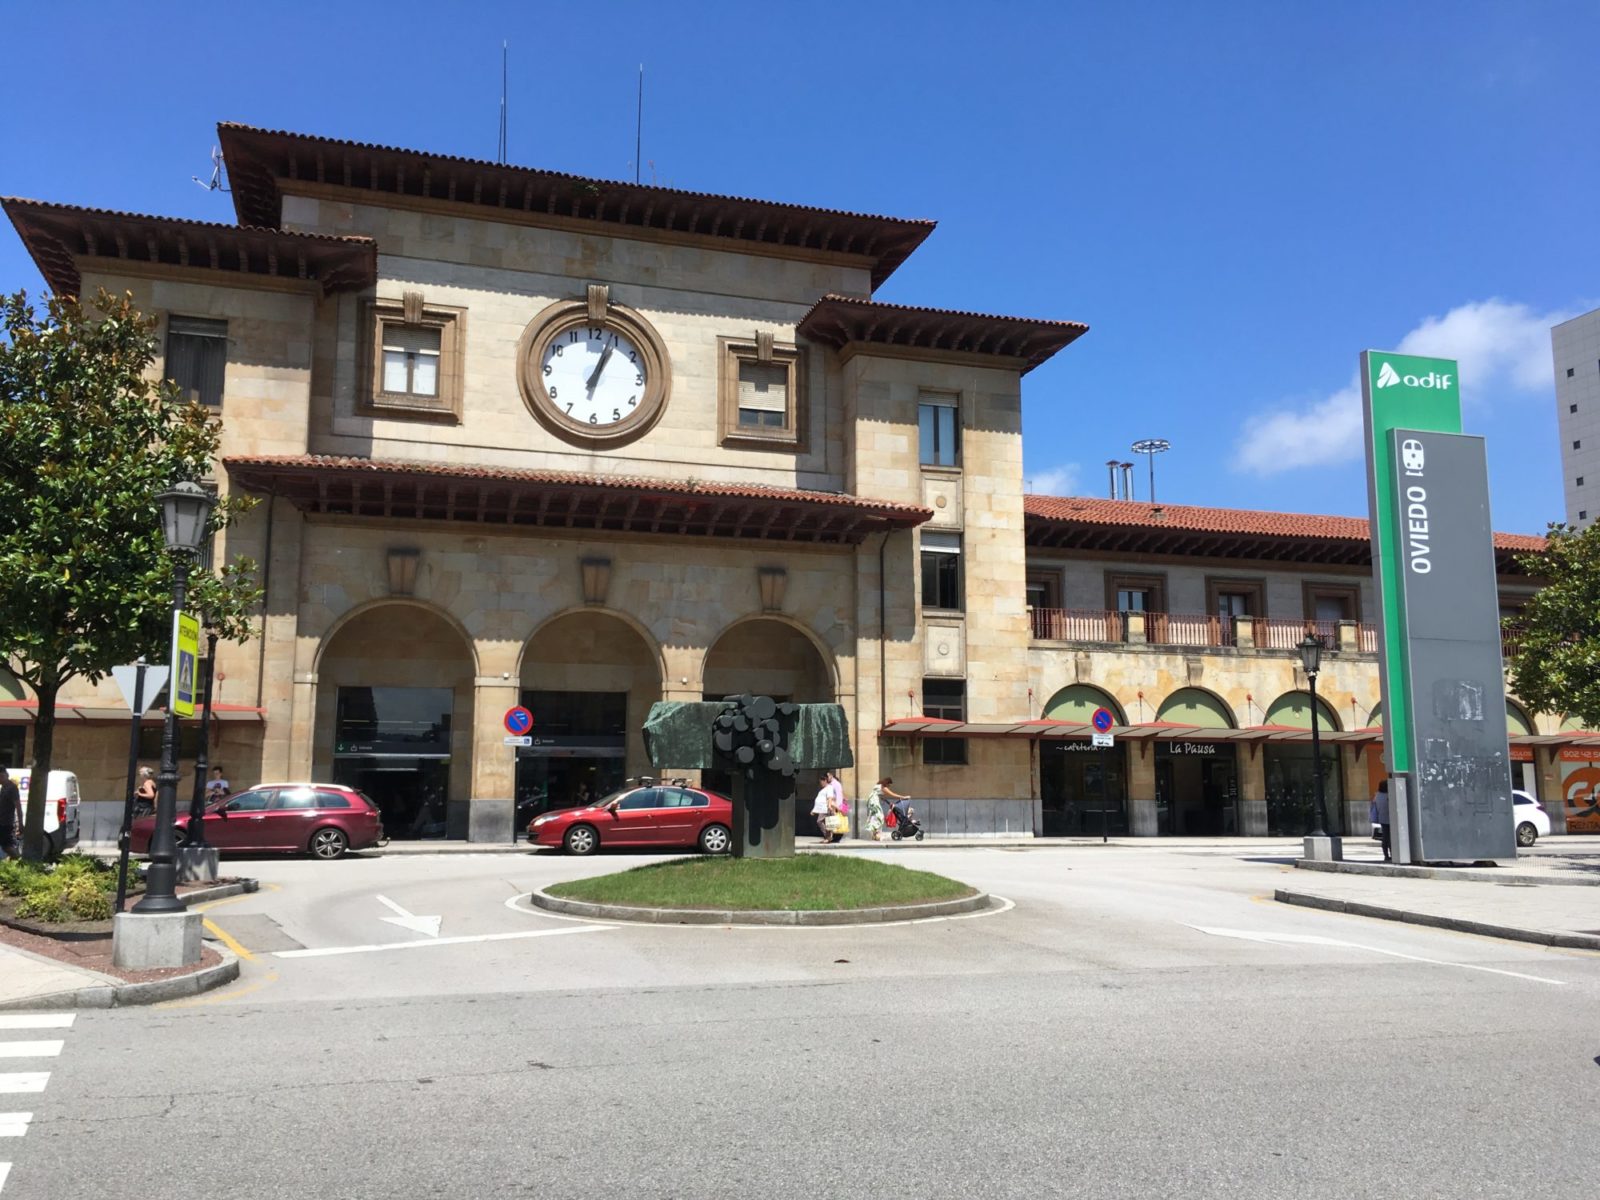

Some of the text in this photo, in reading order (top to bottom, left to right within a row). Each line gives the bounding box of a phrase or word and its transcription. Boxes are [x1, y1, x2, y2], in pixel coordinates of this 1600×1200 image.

[569, 331, 578, 343] 11
[588, 328, 602, 340] 12
[614, 335, 618, 347] 1
[552, 344, 563, 357] 10
[629, 351, 636, 363] 2
[543, 365, 552, 376] 9
[635, 374, 643, 386] 3
[1403, 372, 1453, 389] adif
[549, 386, 557, 399] 8
[628, 395, 636, 407] 4
[566, 402, 574, 415] 7
[612, 408, 621, 420] 5
[589, 413, 598, 424] 6
[1407, 486, 1431, 574] OVIEDO
[1170, 741, 1216, 754] La Pausa
